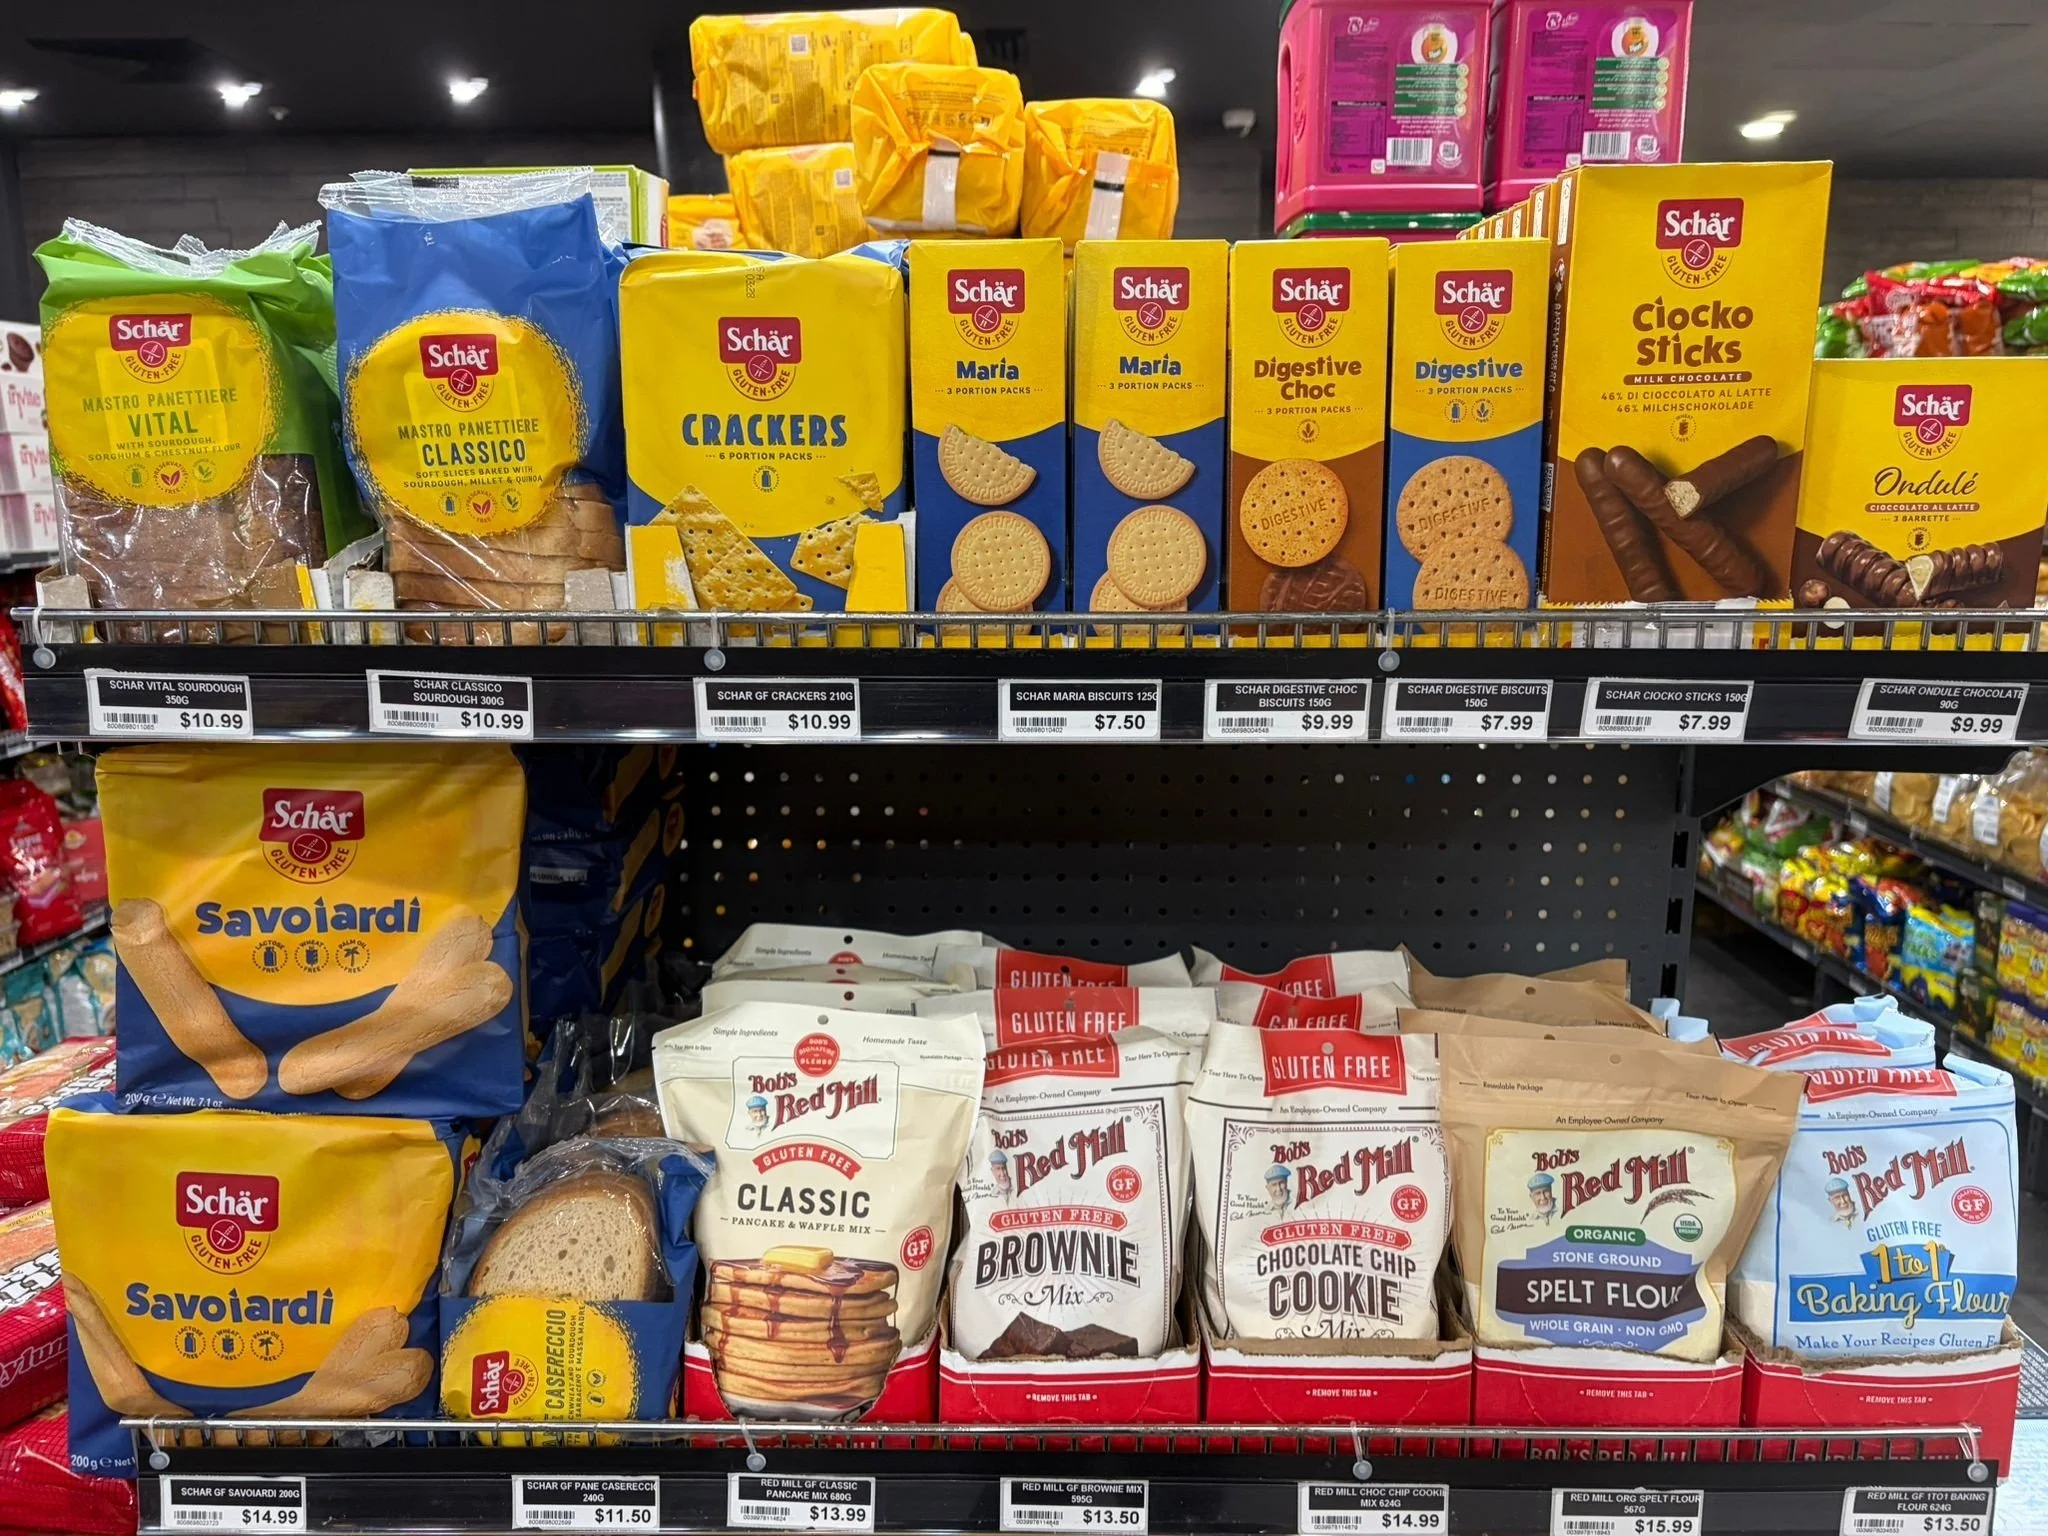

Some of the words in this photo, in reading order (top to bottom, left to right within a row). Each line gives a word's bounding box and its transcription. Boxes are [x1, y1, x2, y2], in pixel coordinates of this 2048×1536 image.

[1664, 210, 1736, 241] Schär
[955, 279, 1018, 308] Schär
[1121, 276, 1183, 304] Schär
[1280, 278, 1344, 306] Schär
[1442, 280, 1505, 308] Schär
[1632, 296, 1754, 332] Ciocko
[117, 319, 183, 341] Schär
[727, 327, 793, 357] Schär
[1636, 332, 1742, 367] Sticks
[429, 344, 489, 370] Schär
[1119, 353, 1181, 375] Maria
[956, 358, 1019, 380] Maria
[1254, 355, 1362, 381] Digestive
[1415, 357, 1523, 383] Digestive
[733, 369, 790, 397] GLUTEN-FREE
[1635, 375, 1663, 384] MILK
[1670, 373, 1743, 383] CHOCOLATE
[1280, 380, 1336, 401] Choc
[82, 394, 140, 412] MASTRO
[148, 389, 238, 407] PANETTIERE
[1902, 394, 1965, 421] Schär
[128, 411, 198, 437] VITAL
[397, 423, 452, 439] MASTRO
[459, 418, 539, 435] PANETTIERE
[682, 414, 847, 446] CRACKERS
[88, 453, 140, 461] SORGHUM
[154, 447, 208, 457] CHESTNUT
[116, 441, 144, 449] WITH
[422, 439, 527, 467] CLASSICO
[1875, 467, 1979, 496] Ondulé
[110, 680, 144, 690] SCHAR
[147, 682, 175, 692] VITAL
[178, 683, 243, 693] SOURDOUGH
[413, 680, 448, 690] SCHAR
[452, 682, 501, 692] CLASSICO
[1235, 685, 1270, 694] SCHAR
[1273, 685, 1325, 694] DIGESTIVE
[1329, 685, 1358, 694] CHOC
[1880, 686, 1916, 694] SCHAR
[1919, 688, 1961, 697] ONDULE
[1963, 690, 2024, 699] CHOCOLATE
[165, 696, 189, 704] 350G
[413, 693, 477, 705] SOURDOUGH
[481, 696, 504, 705] 300G
[718, 692, 752, 700] SCHAR
[755, 692, 768, 700] GF
[771, 692, 826, 700] CRACKERS
[830, 692, 852, 700] 210G
[1016, 692, 1050, 700] SCHAR
[1053, 692, 1085, 700] MARIA
[1088, 692, 1133, 700] BISCUITS
[1259, 699, 1305, 707] BISCUITS
[1308, 699, 1331, 707] 150G
[1606, 691, 1640, 700] SCHAR
[1643, 692, 1683, 700] CIOCKO
[1685, 692, 1721, 701] STICKS
[1725, 694, 1748, 702] 150G
[1940, 701, 1959, 709] 90G
[181, 712, 243, 729] $10.99
[461, 711, 523, 729] $10.99
[789, 714, 850, 730] $10.99
[1095, 714, 1145, 731] $7.50
[1302, 714, 1353, 730] $9.99
[1679, 714, 1730, 731] $7.99
[1951, 716, 2003, 733] $9.99
[271, 800, 354, 835] Schär
[270, 846, 350, 879] GLUTEN-FREE
[195, 896, 421, 937] Savoiardi
[1271, 1057, 1335, 1079] GLUTEN
[1344, 1056, 1391, 1078] FREE
[748, 1072, 798, 1094] Bob's
[773, 1084, 825, 1131] Red
[826, 1073, 880, 1119] Mill
[763, 1147, 814, 1167] GLUTEN
[820, 1150, 852, 1172] FREE
[186, 1184, 269, 1224] Schär
[738, 1184, 870, 1218] CLASSIC
[1001, 1211, 1065, 1226] GLUTEN
[1069, 1209, 1113, 1225] FREE
[1574, 1230, 1635, 1241] ORGANIC
[190, 1234, 262, 1269] GLUTEN-FREE
[975, 1231, 1140, 1288] BROWNIE
[1552, 1252, 1594, 1264] STONE
[1599, 1253, 1661, 1268] GROUND
[1257, 1244, 1363, 1277] CHOCOLATE
[1370, 1249, 1416, 1279] CHIP
[1024, 1284, 1083, 1306] Mix
[1268, 1270, 1403, 1325] COOKIE
[1526, 1280, 1594, 1304] SPELT
[126, 1282, 334, 1325] Savoiardi
[1797, 1282, 1921, 1328] Baking
[1925, 1280, 2009, 1323] Flour
[545, 1309, 566, 1410] CASERECCIO
[479, 1358, 504, 1411] Schär
[1586, 1389, 1617, 1398] REMOVE
[1619, 1389, 1632, 1398] THIS
[1634, 1389, 1648, 1398] TAB
[181, 1488, 212, 1496] SCHAR
[214, 1488, 225, 1496] GF
[228, 1489, 276, 1497] SAVOIARDI
[279, 1490, 300, 1498] 200G
[527, 1482, 558, 1490] SCHAR
[561, 1482, 572, 1490] GF
[575, 1482, 599, 1490] PANE
[761, 1479, 779, 1487] RED
[782, 1480, 802, 1488] MILL
[819, 1481, 858, 1490] CLASSIC
[1315, 1488, 1333, 1496] RED
[1336, 1488, 1357, 1496] MILL
[1360, 1488, 1385, 1496] CHOC
[583, 1494, 604, 1502] 240G
[766, 1490, 809, 1500] PANCAKE
[812, 1491, 828, 1500] MIX
[830, 1492, 851, 1501] 680G
[1360, 1499, 1377, 1507] MIX
[1379, 1499, 1400, 1507] 624G
[1592, 1494, 1613, 1502] MILL
[1616, 1494, 1636, 1502] ORG
[1639, 1494, 1668, 1503] SPELT
[1670, 1495, 1700, 1503] FLOUR
[1888, 1492, 1909, 1500] MILL
[242, 1509, 297, 1524] $14.99
[595, 1508, 650, 1524] $11.50
[810, 1506, 866, 1521] $13.99
[1624, 1505, 1645, 1513] 567G
[1897, 1503, 1927, 1511] FLOUR
[1930, 1503, 1951, 1511] 624G
[1382, 1514, 1439, 1528] $14.99
[1635, 1519, 1692, 1533] $15.99
[1924, 1517, 1980, 1532] $13.50
